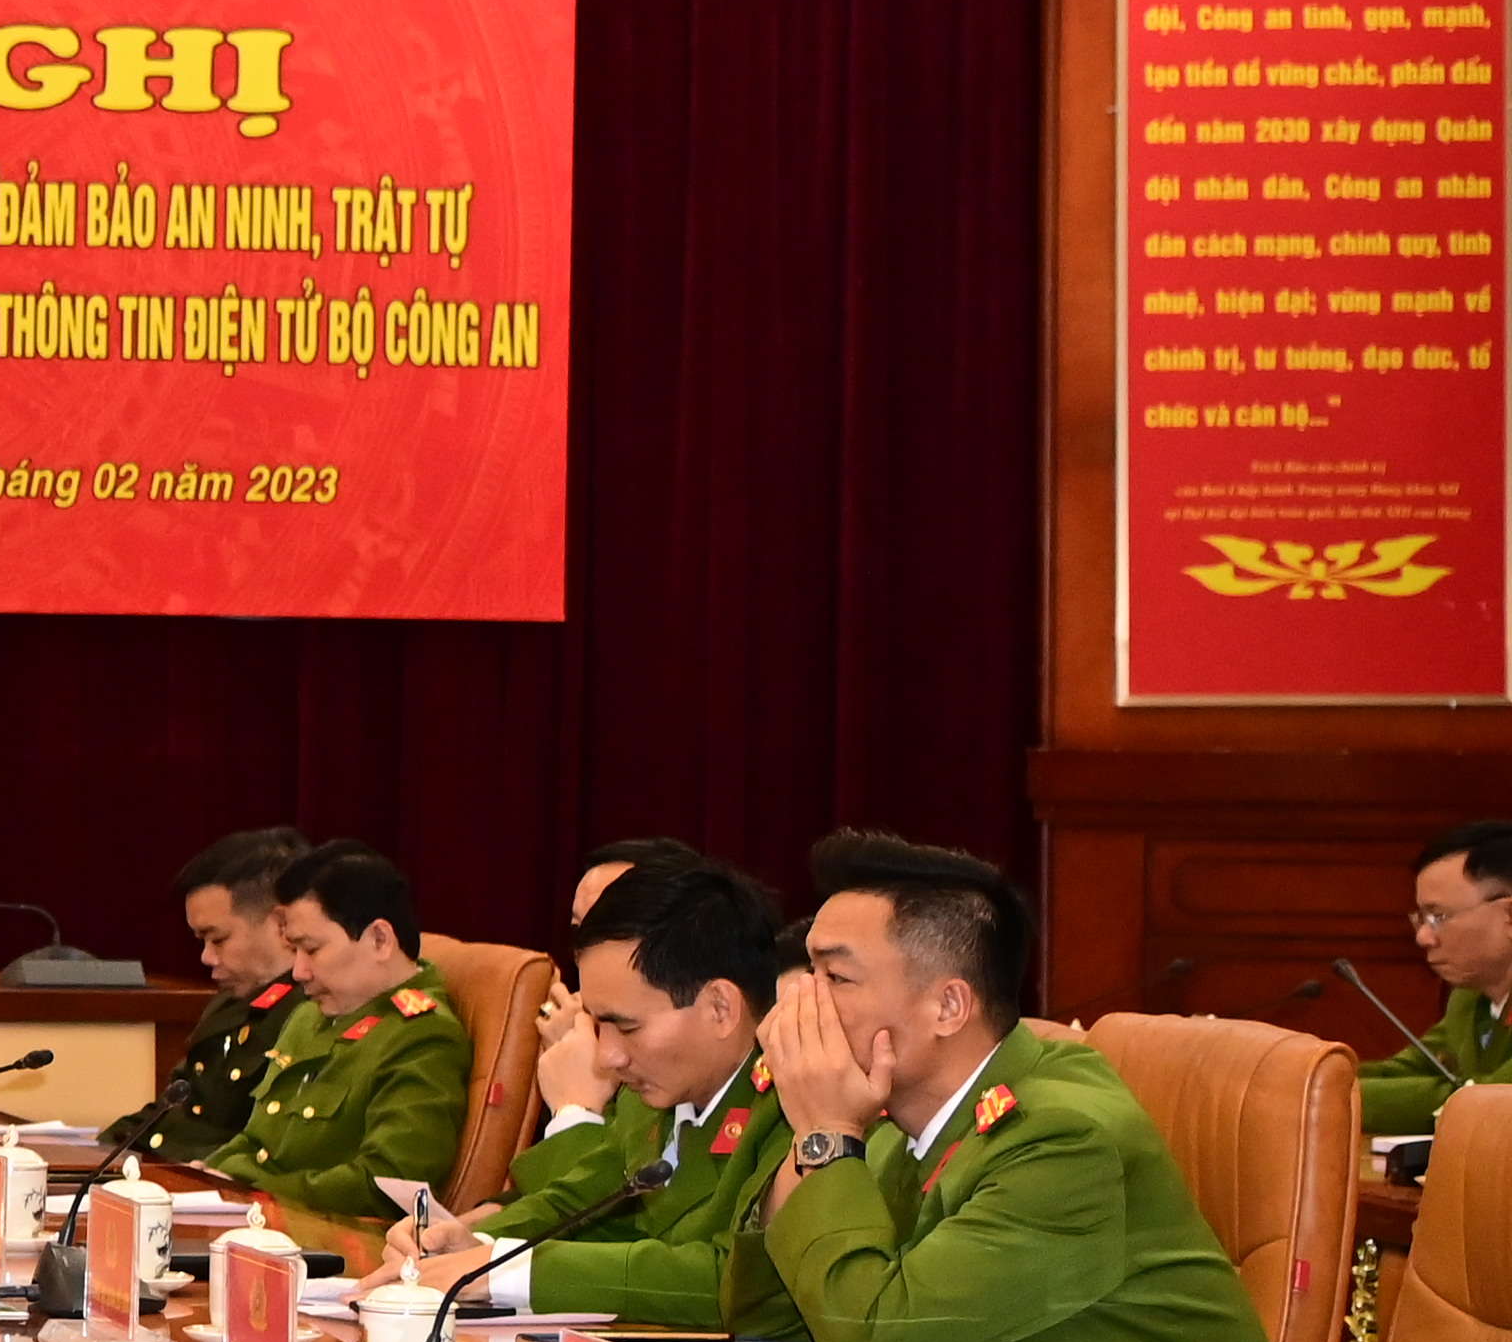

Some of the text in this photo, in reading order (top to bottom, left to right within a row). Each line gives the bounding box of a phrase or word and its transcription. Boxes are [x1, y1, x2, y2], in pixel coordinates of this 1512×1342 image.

[86, 161, 156, 248] BẢO
[165, 184, 216, 249] AN
[226, 185, 321, 259] NINH,
[332, 175, 417, 267] TRẬT
[425, 184, 473, 268] TỰ
[118, 295, 174, 360] TIN
[184, 284, 266, 376] ĐIỆN
[276, 281, 323, 364] TỬ
[328, 287, 375, 379] BỘ
[385, 287, 480, 367] CÔNG
[489, 303, 539, 368] AN
[93, 462, 139, 499] 02
[150, 463, 234, 501] năm
[245, 465, 338, 504] 2023
